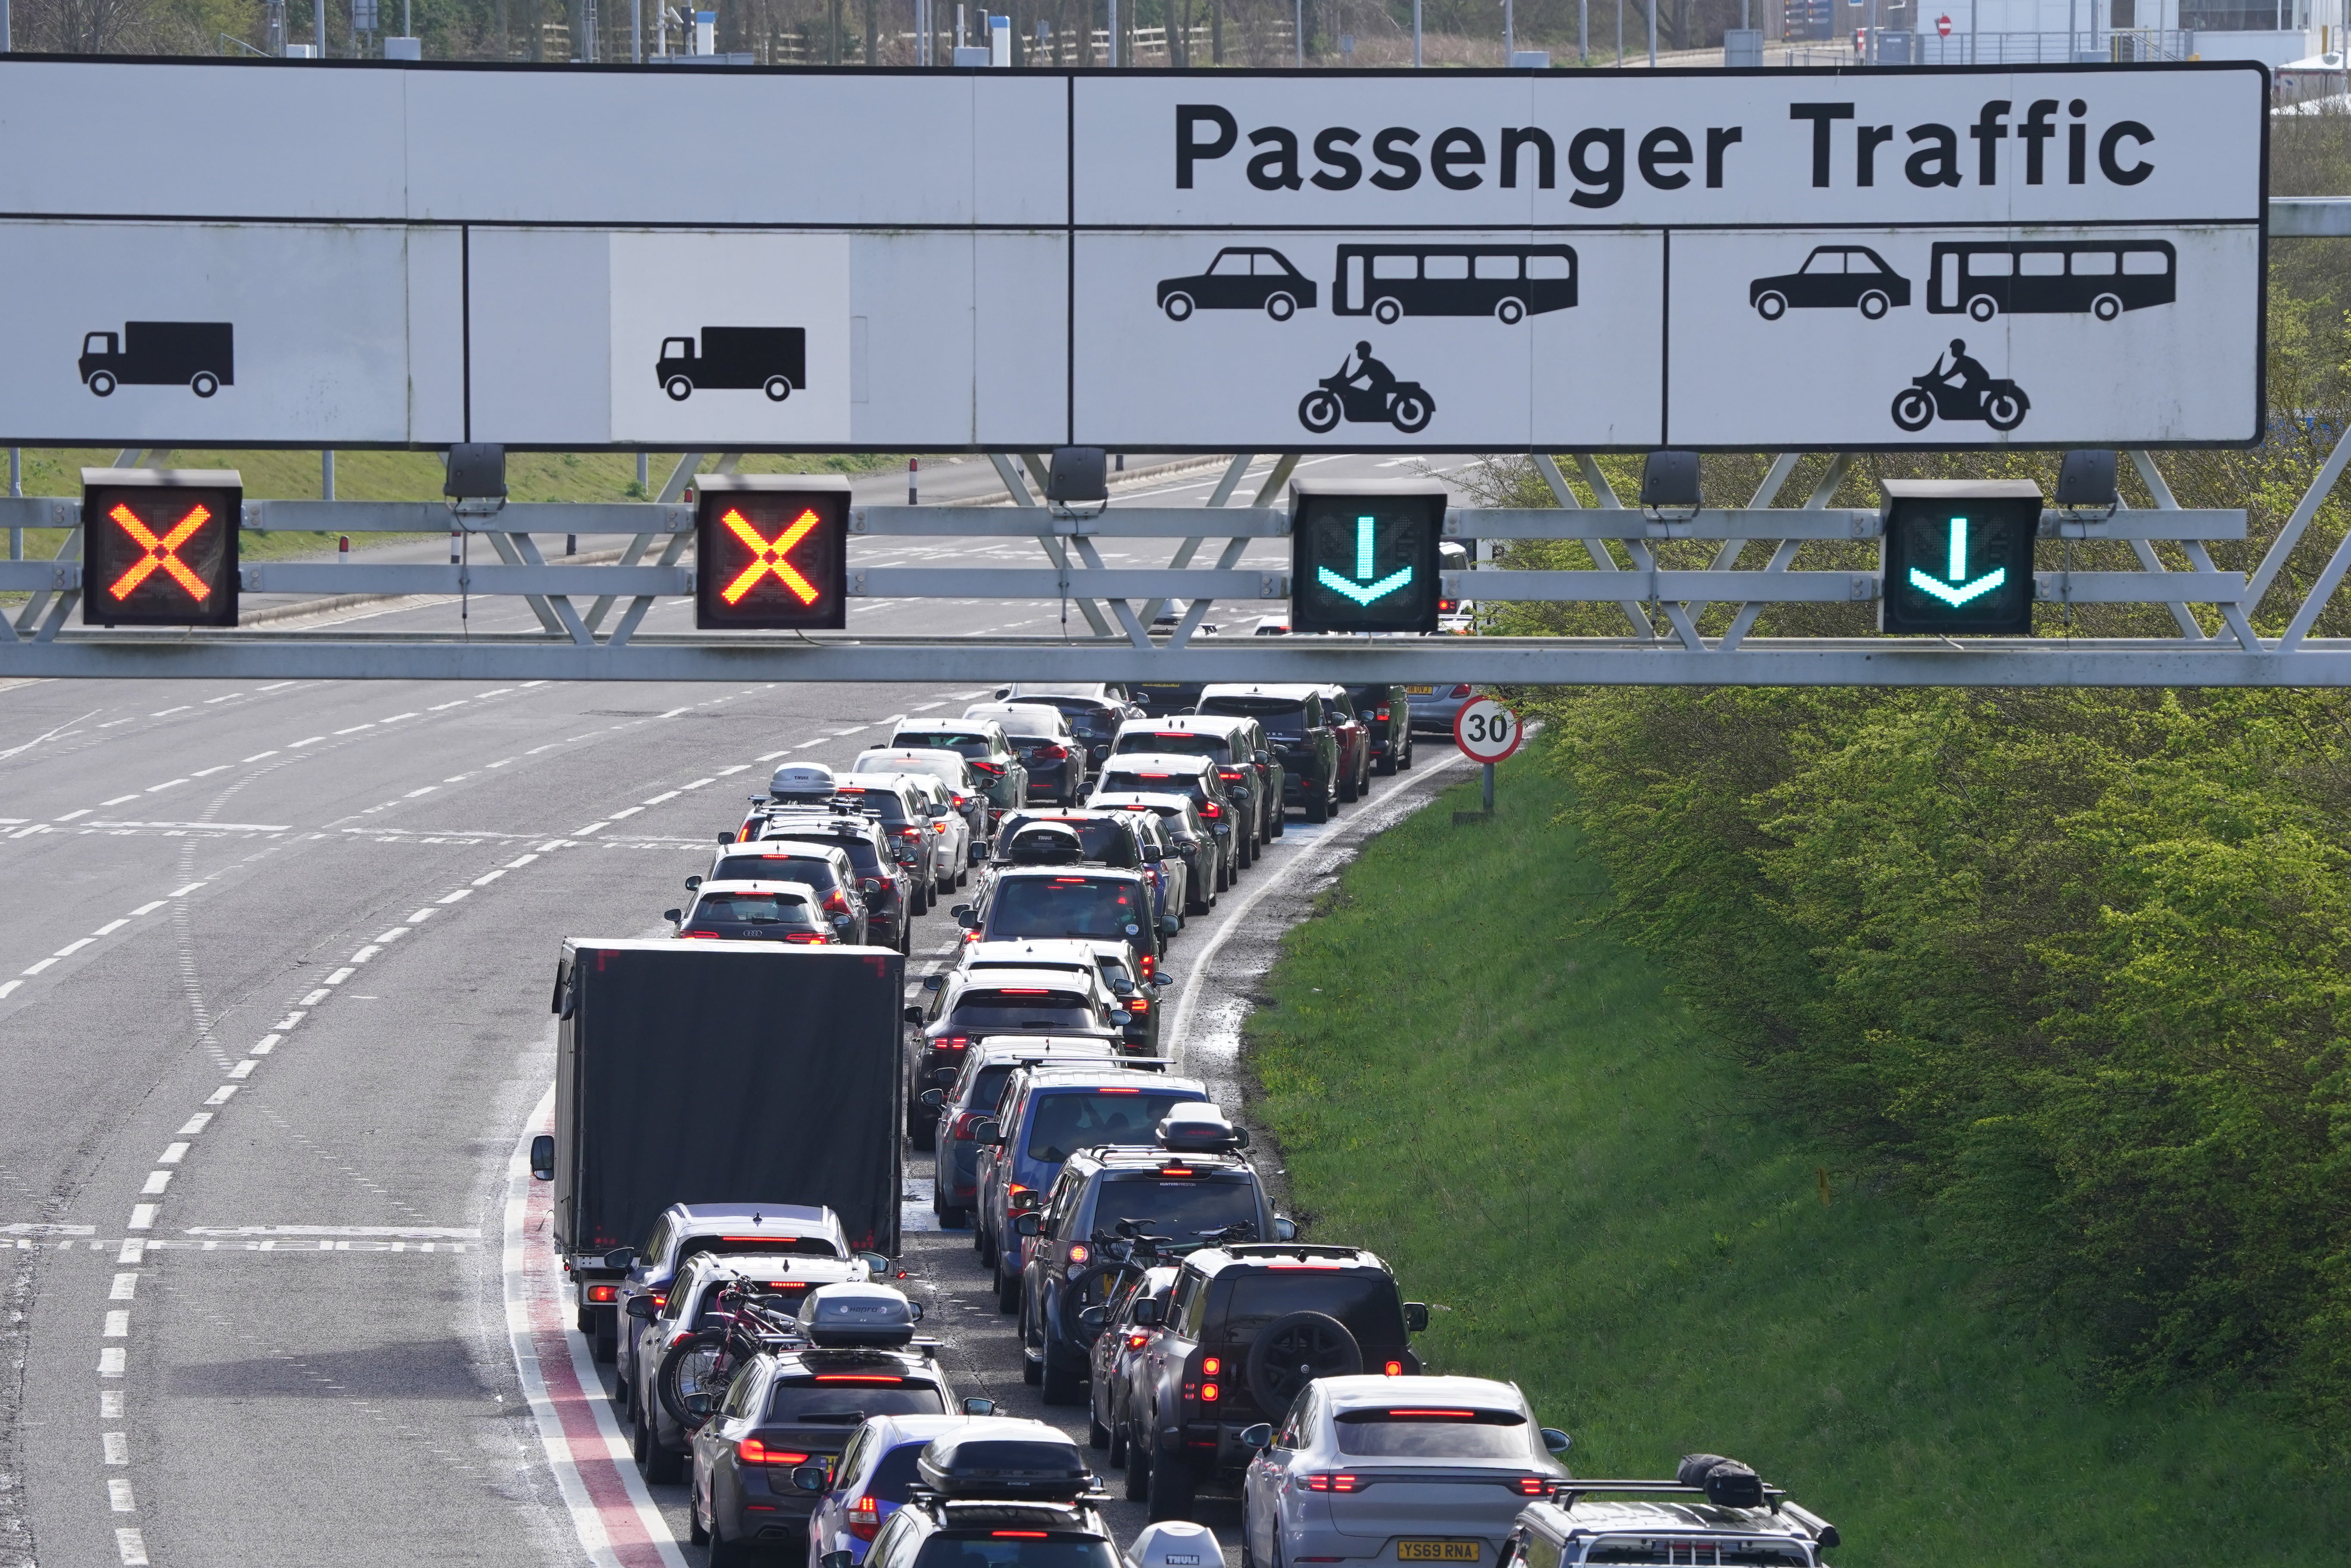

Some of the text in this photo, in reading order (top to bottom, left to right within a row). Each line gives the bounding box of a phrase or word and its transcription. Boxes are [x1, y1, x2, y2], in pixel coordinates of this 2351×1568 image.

[1176, 99, 2155, 207] Passenger Traffic
[1468, 713, 1507, 743] 30
[1167, 1556, 1199, 1565] THULE
[1404, 1543, 1472, 1558] YS69 RNA
